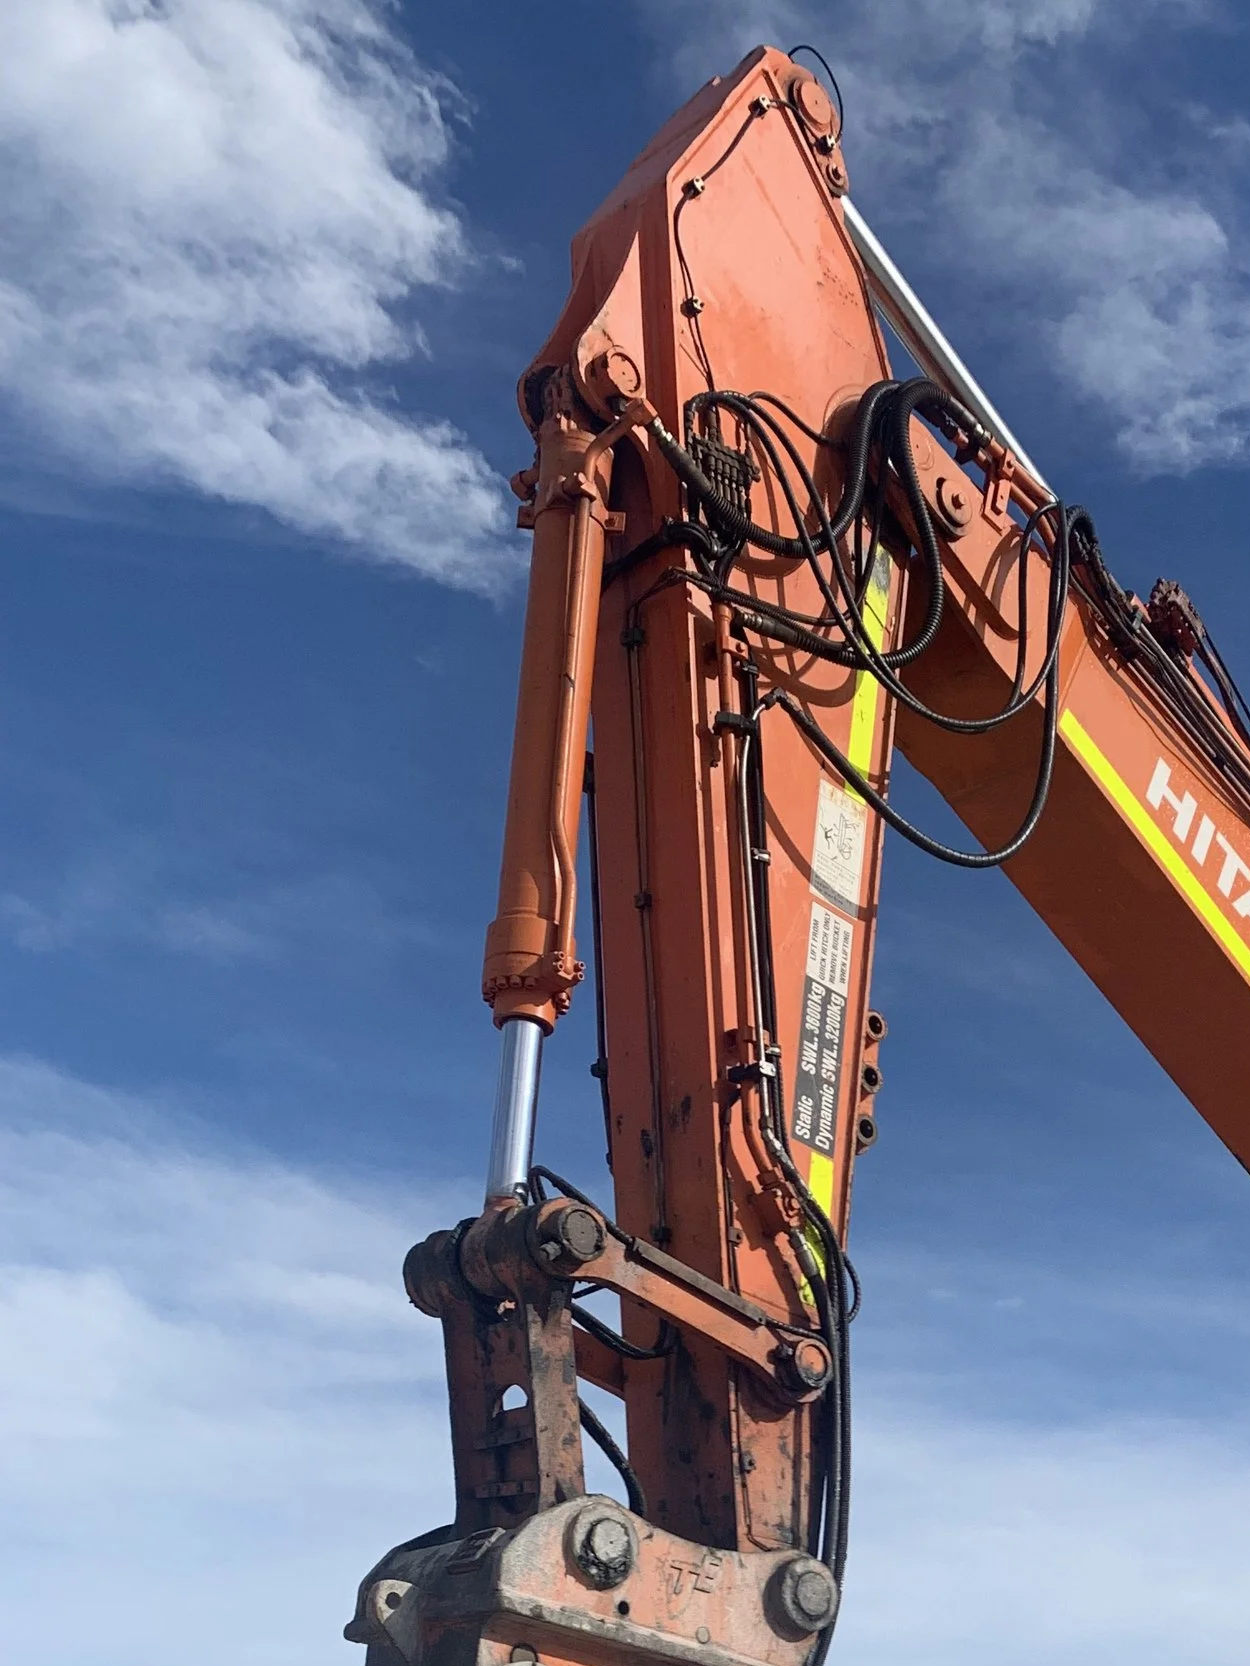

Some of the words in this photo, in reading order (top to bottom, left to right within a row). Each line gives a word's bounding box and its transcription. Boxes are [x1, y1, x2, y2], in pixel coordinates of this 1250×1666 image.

[811, 919, 819, 941] FROM
[823, 912, 831, 931] ONLY
[821, 932, 829, 956] HITCH
[832, 920, 841, 950] BUCKET
[842, 930, 850, 960] LIFTING
[810, 942, 818, 961] LIFT
[819, 957, 827, 981] QUICK
[829, 953, 837, 984] REMOVE
[839, 962, 847, 984] WHEN
[795, 1095, 814, 1139] Static
[805, 981, 826, 1034] 3600kg
[815, 1084, 835, 1150] Dynamic
[825, 992, 845, 1044] 3200kg
